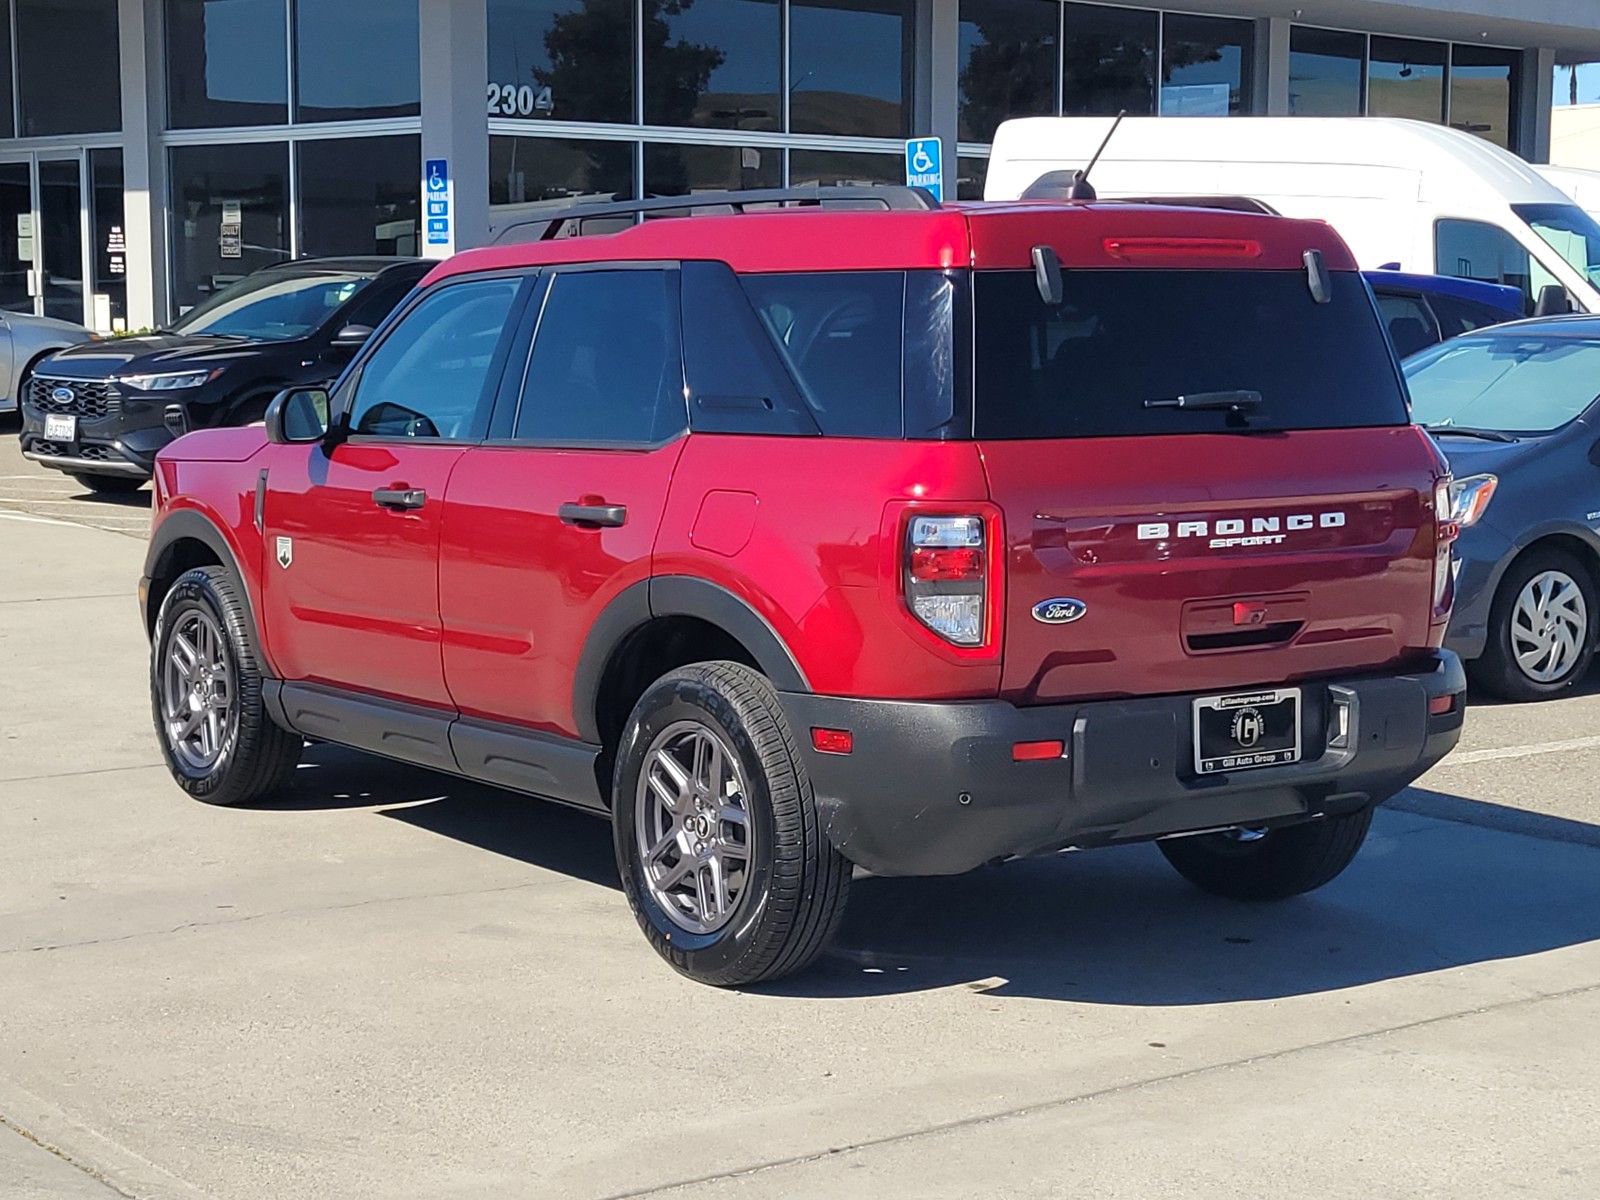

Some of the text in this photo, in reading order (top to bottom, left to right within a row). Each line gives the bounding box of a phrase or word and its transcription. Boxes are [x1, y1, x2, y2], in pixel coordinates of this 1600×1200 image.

[487, 82, 555, 116] 2304
[909, 173, 941, 187] PARKING
[1137, 512, 1345, 540] BRONCO
[1208, 534, 1287, 549] SPORT
[1045, 602, 1076, 618] Ford
[1222, 758, 1235, 767] Gill
[1236, 756, 1253, 766] Auto
[1254, 754, 1276, 764] Group
